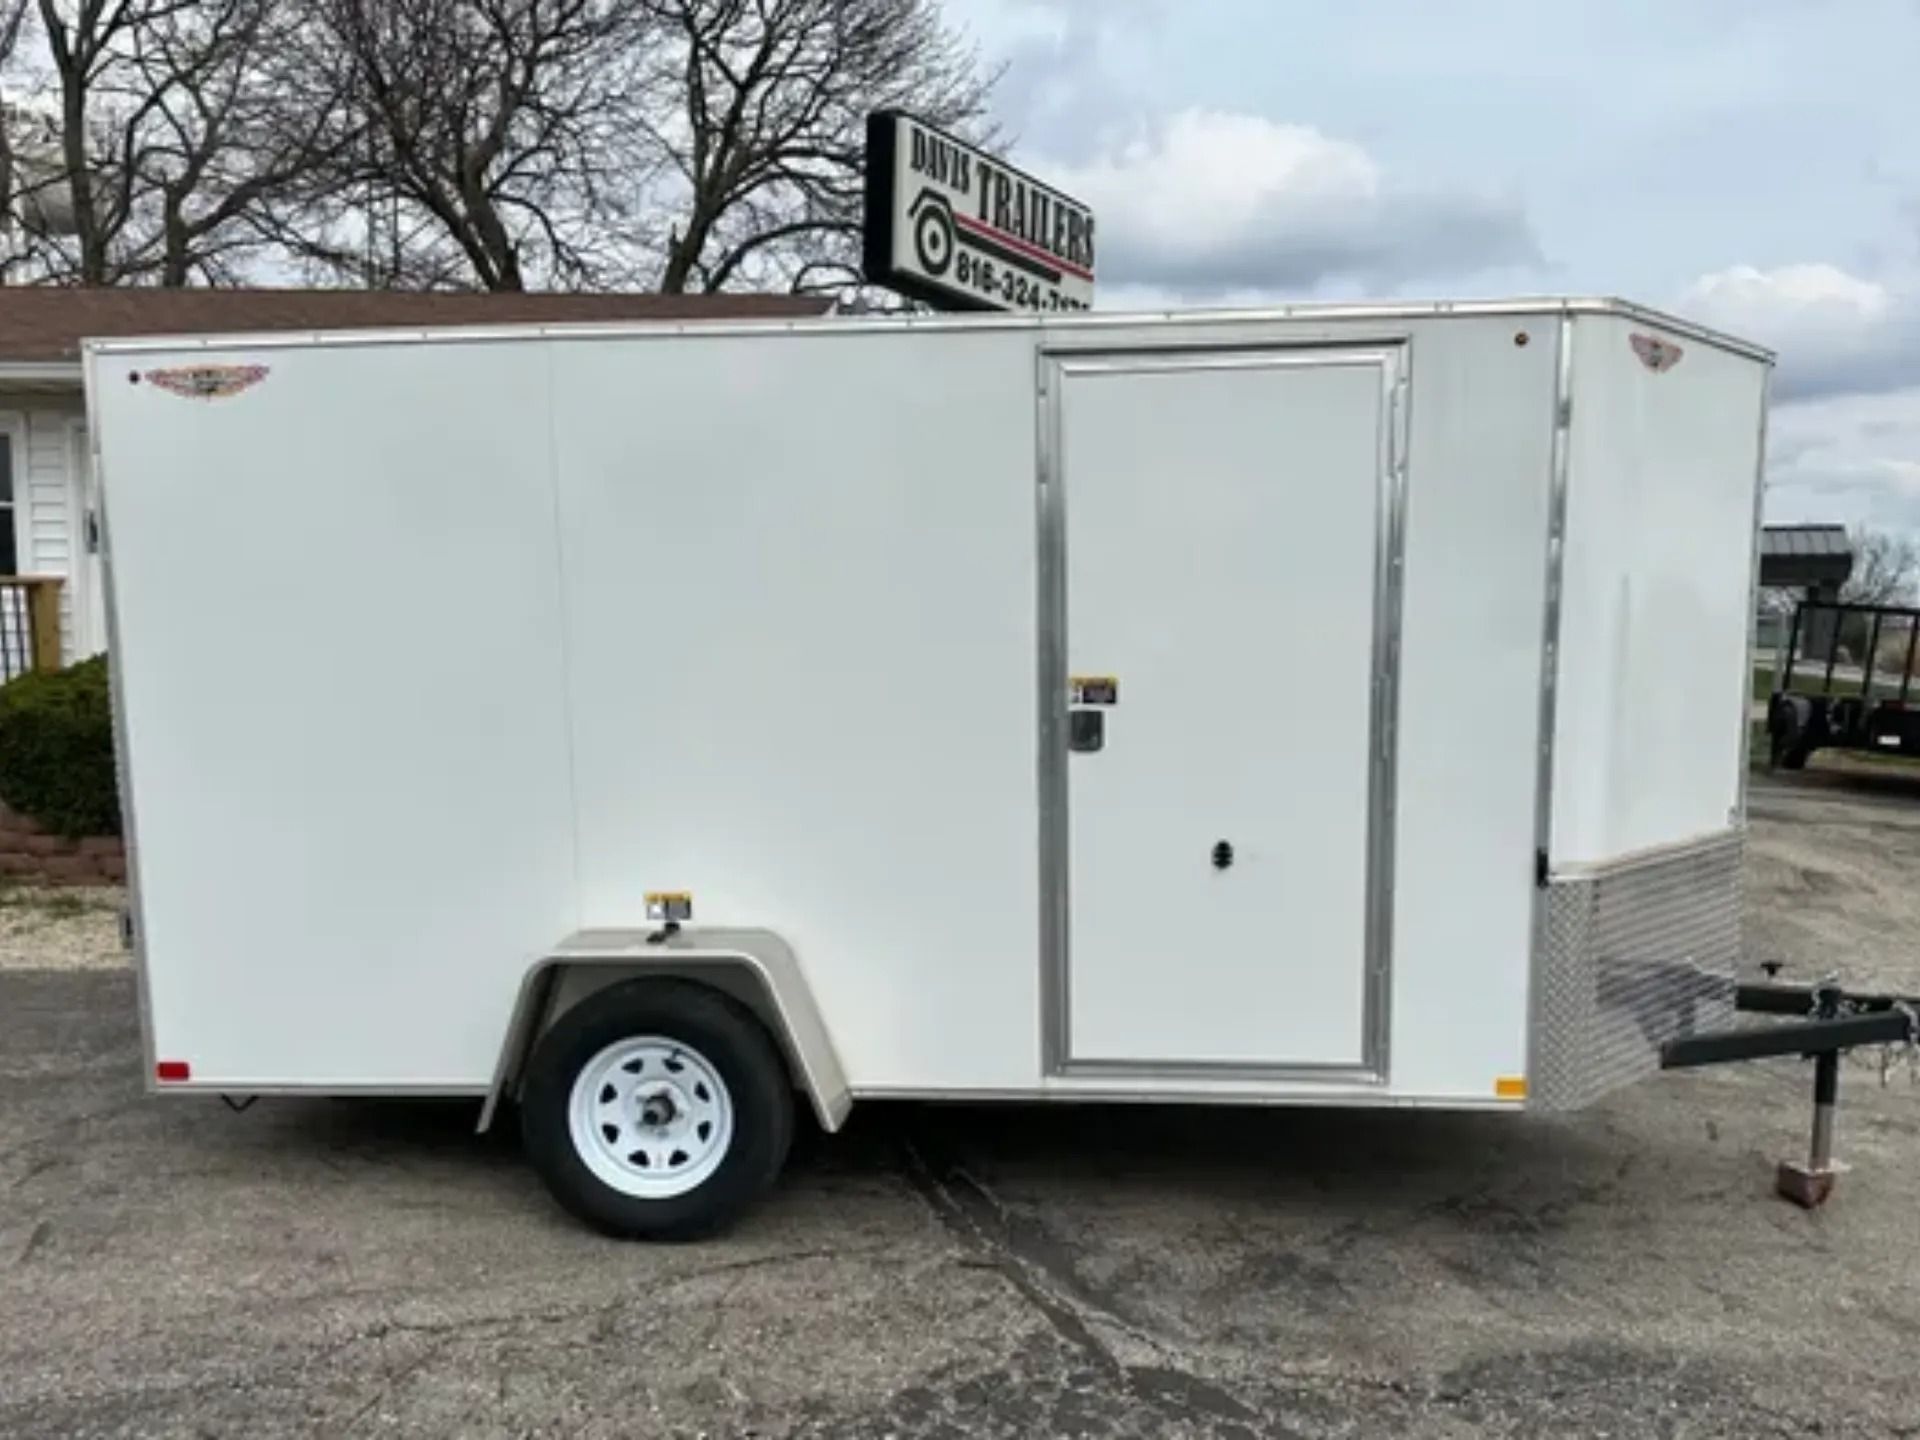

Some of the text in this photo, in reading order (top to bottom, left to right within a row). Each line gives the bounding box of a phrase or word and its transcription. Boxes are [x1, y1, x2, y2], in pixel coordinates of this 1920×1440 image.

[910, 126, 1095, 269] DAVIS TRAILERS
[956, 250, 1089, 312] 816-324-7
